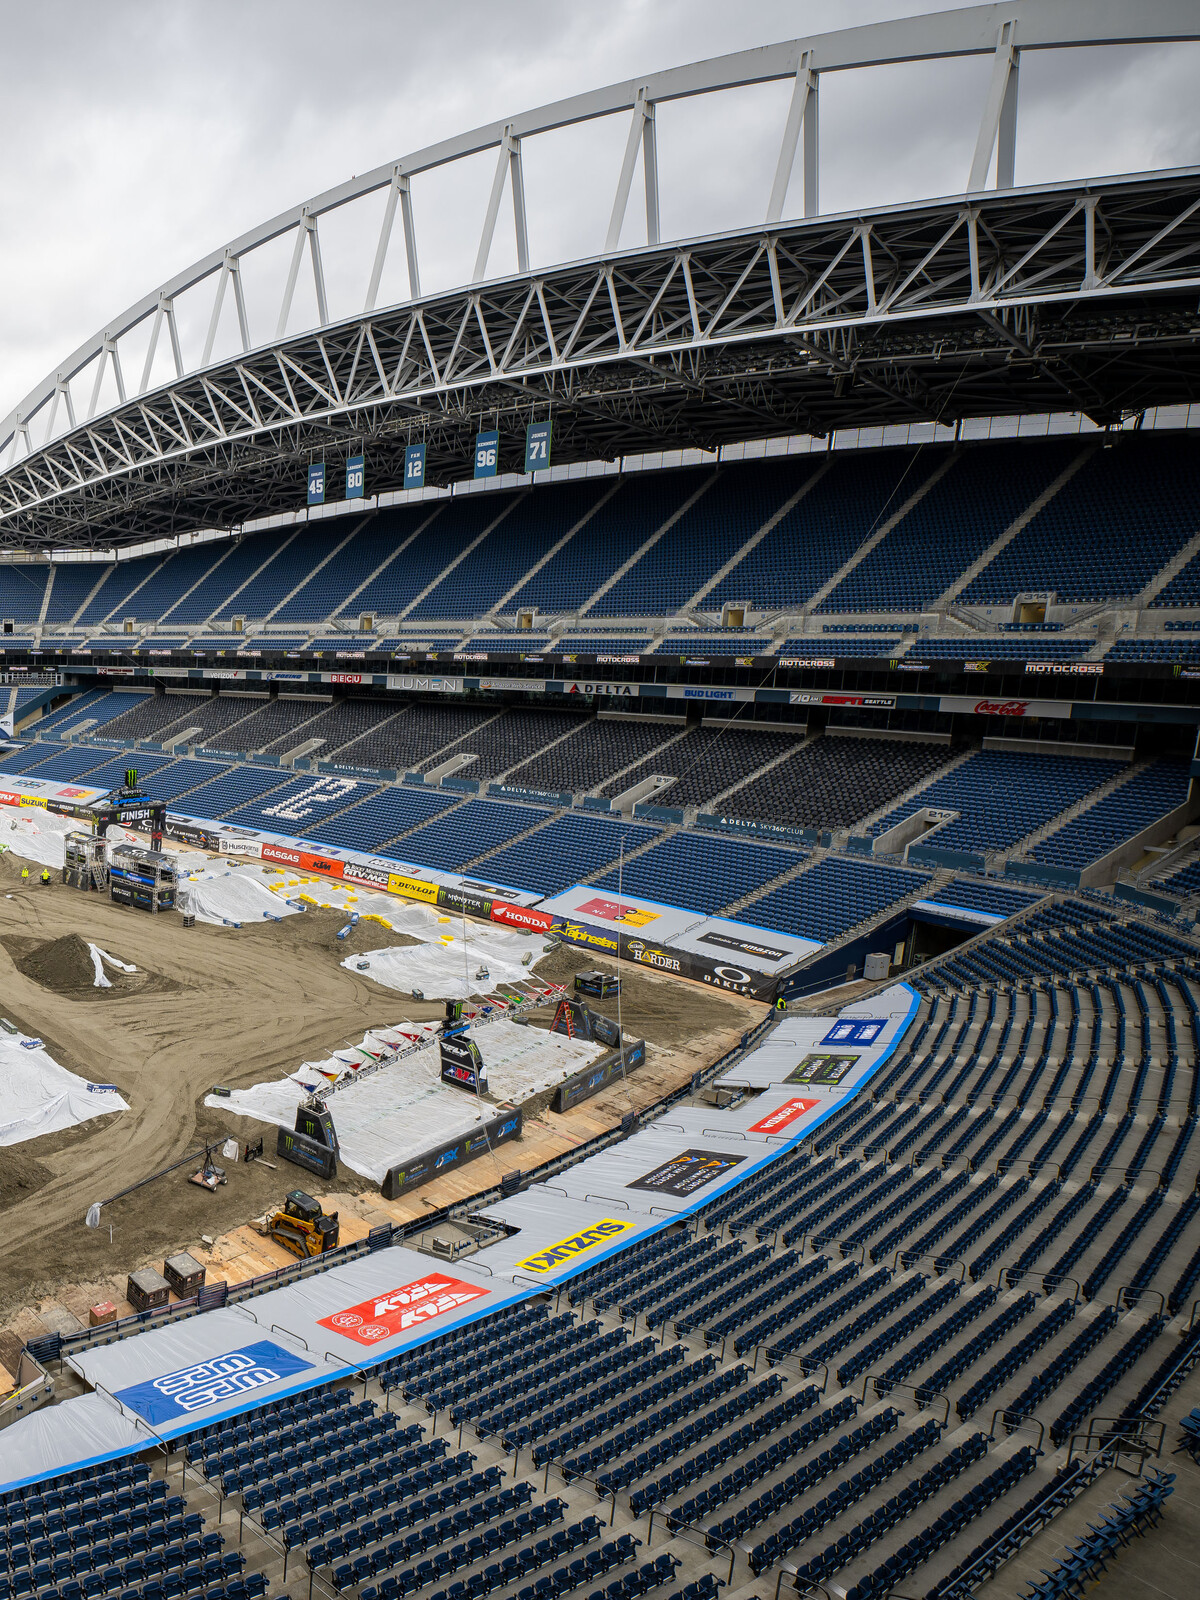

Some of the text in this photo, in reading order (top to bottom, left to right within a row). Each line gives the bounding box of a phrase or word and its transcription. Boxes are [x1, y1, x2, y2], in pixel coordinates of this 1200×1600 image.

[477, 449, 496, 467] 96
[530, 441, 546, 460] 71
[408, 460, 422, 478] 12
[309, 479, 324, 494] 45
[348, 472, 362, 488] 80
[210, 672, 235, 680] verizon
[1025, 665, 1104, 674] MOTOCROSS
[331, 675, 362, 683] BECU
[391, 678, 457, 691] LUMEN
[584, 684, 632, 695] DELTA
[684, 689, 734, 698] BUD LIGHT
[790, 694, 810, 702] 710
[822, 696, 864, 705] ESPN
[974, 700, 1030, 716] Coca-Cola
[506, 786, 527, 794] DELTA
[21, 798, 47, 808] SUZUKI
[120, 809, 150, 822] FINISH
[729, 818, 757, 829] DELTA
[228, 843, 259, 854] Husqvarna
[263, 848, 300, 863] GASGAS
[312, 861, 332, 871] KTM
[366, 867, 389, 878] MOUNTAIN
[398, 882, 436, 895] DUNLOP
[448, 894, 481, 907] MONSTER
[506, 912, 549, 929] HONDA
[568, 926, 618, 950] alpinestars
[740, 943, 783, 958] amazon
[634, 950, 681, 971] HARDER
[704, 974, 757, 996] OAKLEY
[760, 1106, 798, 1130] HONDA
[523, 1222, 625, 1270] SUZUKI
[375, 1282, 452, 1317] FLY
[401, 1293, 481, 1328] FLY
[153, 1354, 256, 1395] WPS
[174, 1367, 281, 1411] WPS
